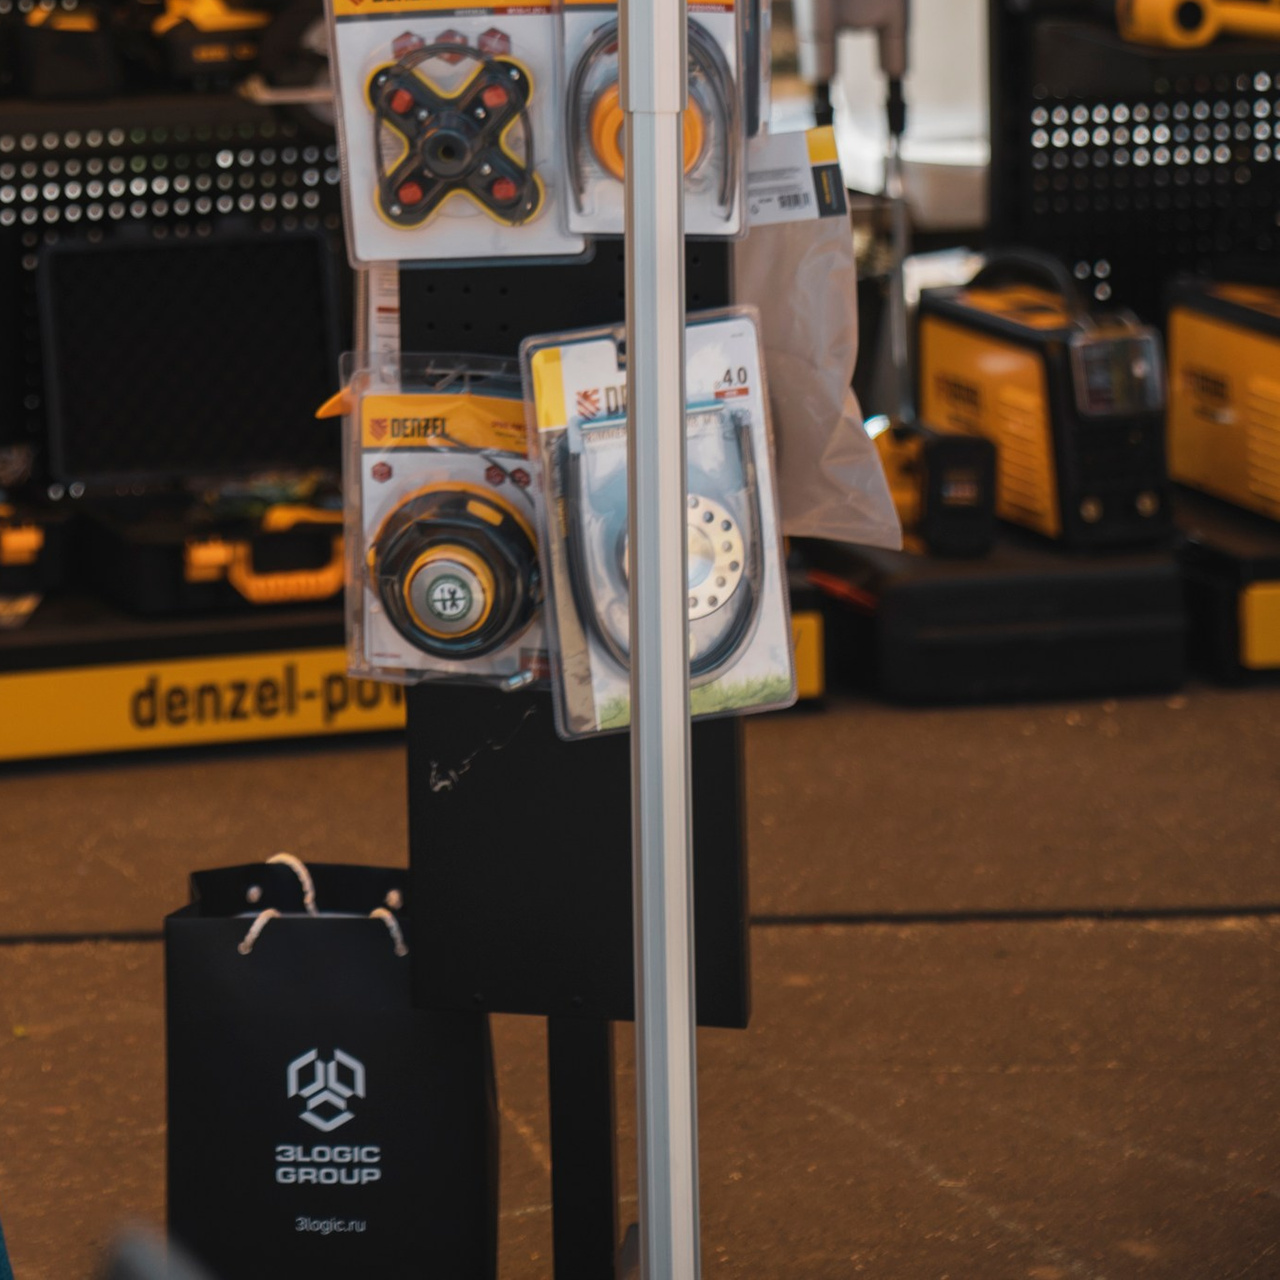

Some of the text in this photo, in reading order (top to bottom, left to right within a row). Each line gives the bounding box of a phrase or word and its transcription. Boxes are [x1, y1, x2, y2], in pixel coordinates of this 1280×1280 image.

[391, 417, 449, 437] DENZEL
[275, 1144, 381, 1163] 3LOGIC
[275, 1166, 382, 1185] GROUP
[295, 1216, 367, 1235] 3logic.ru
